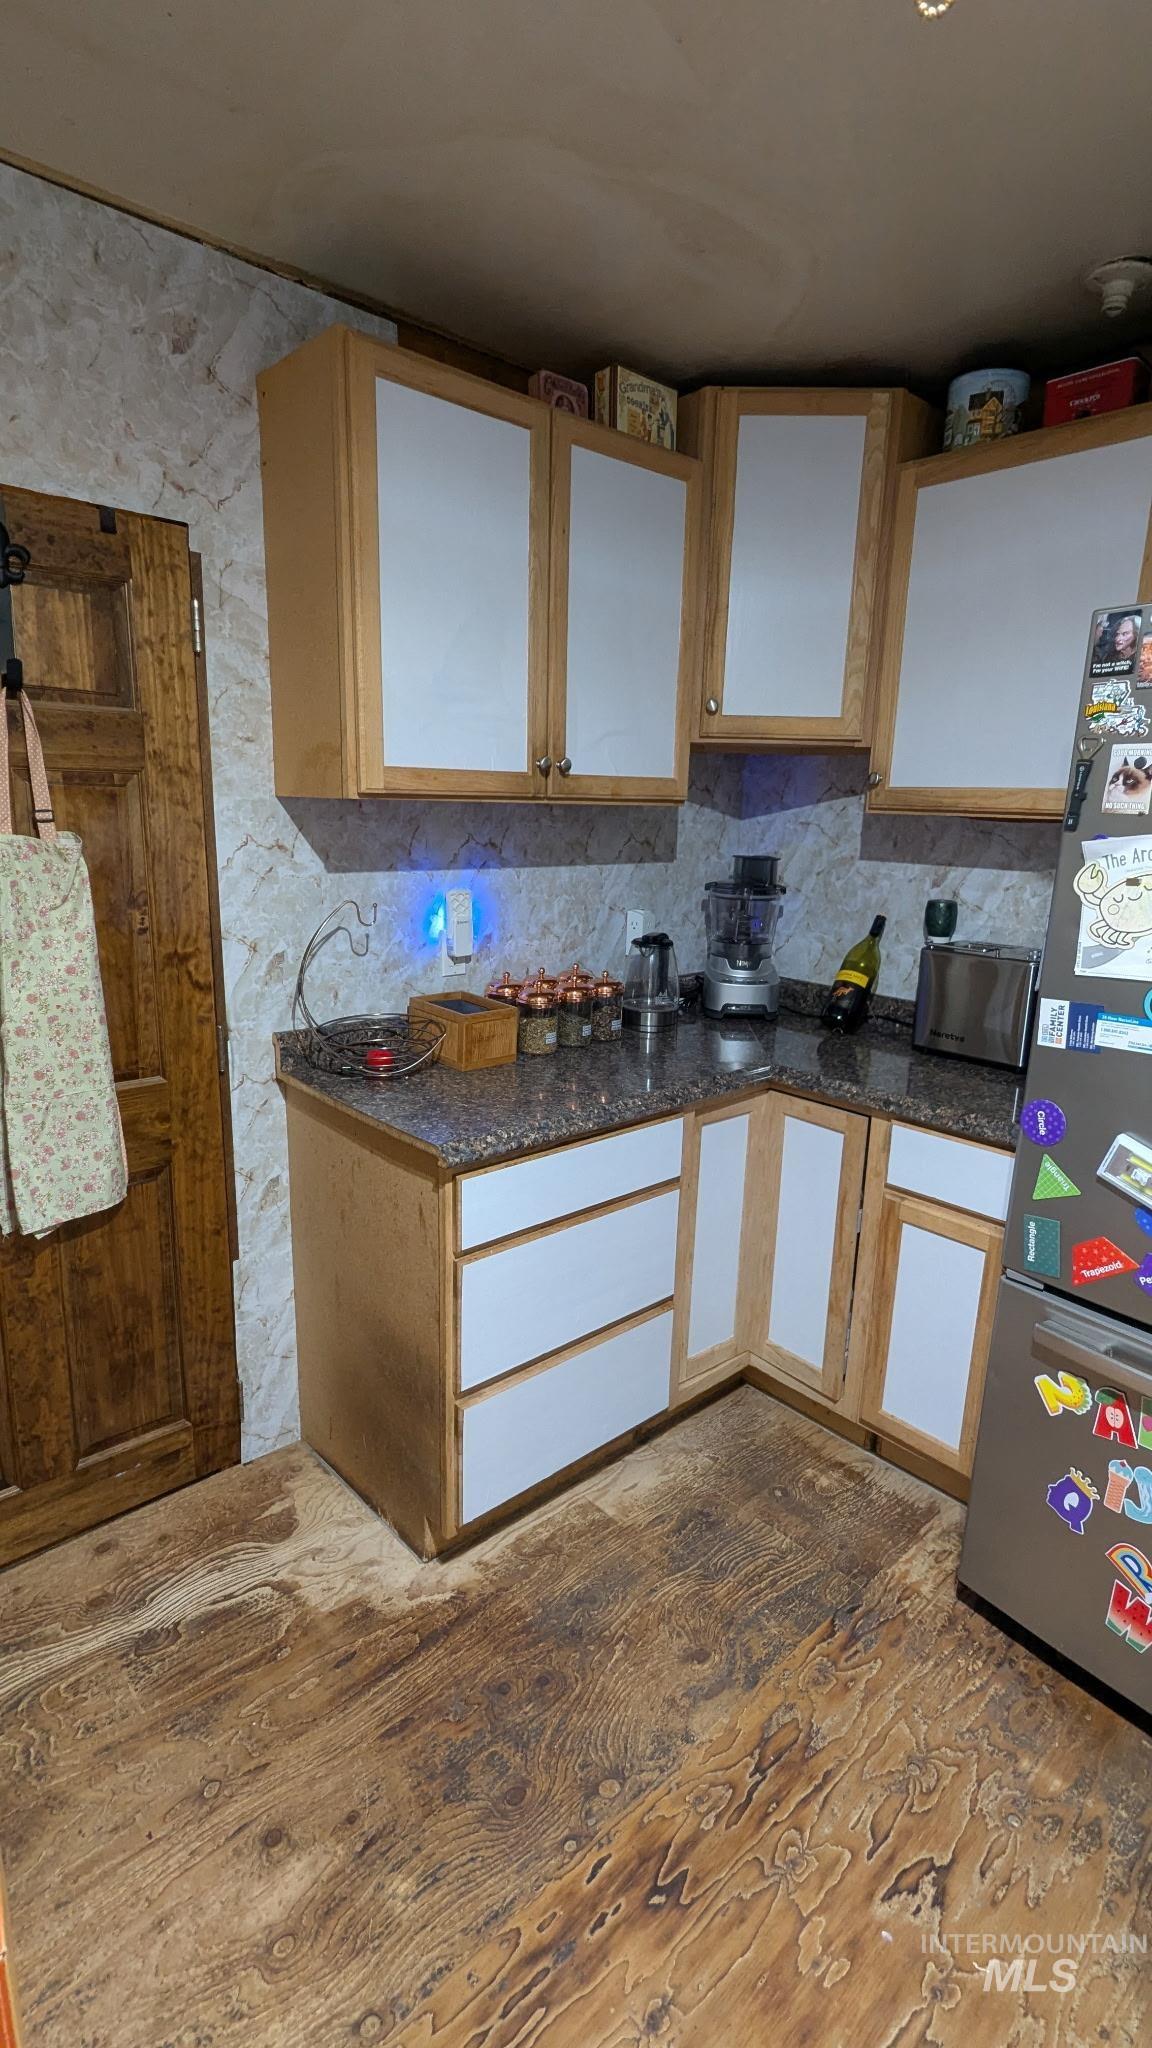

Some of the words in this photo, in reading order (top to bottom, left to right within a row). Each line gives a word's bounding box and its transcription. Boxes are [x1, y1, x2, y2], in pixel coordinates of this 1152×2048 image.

[1102, 854, 1127, 870] The
[1049, 1007, 1058, 1036] FAMILY
[1055, 1005, 1065, 1038] CENTER
[1037, 1110, 1046, 1136] Circle
[1044, 1161, 1070, 1193] Triangle
[1027, 1221, 1036, 1262] Rectangle
[1080, 1260, 1124, 1279] Trapezoid
